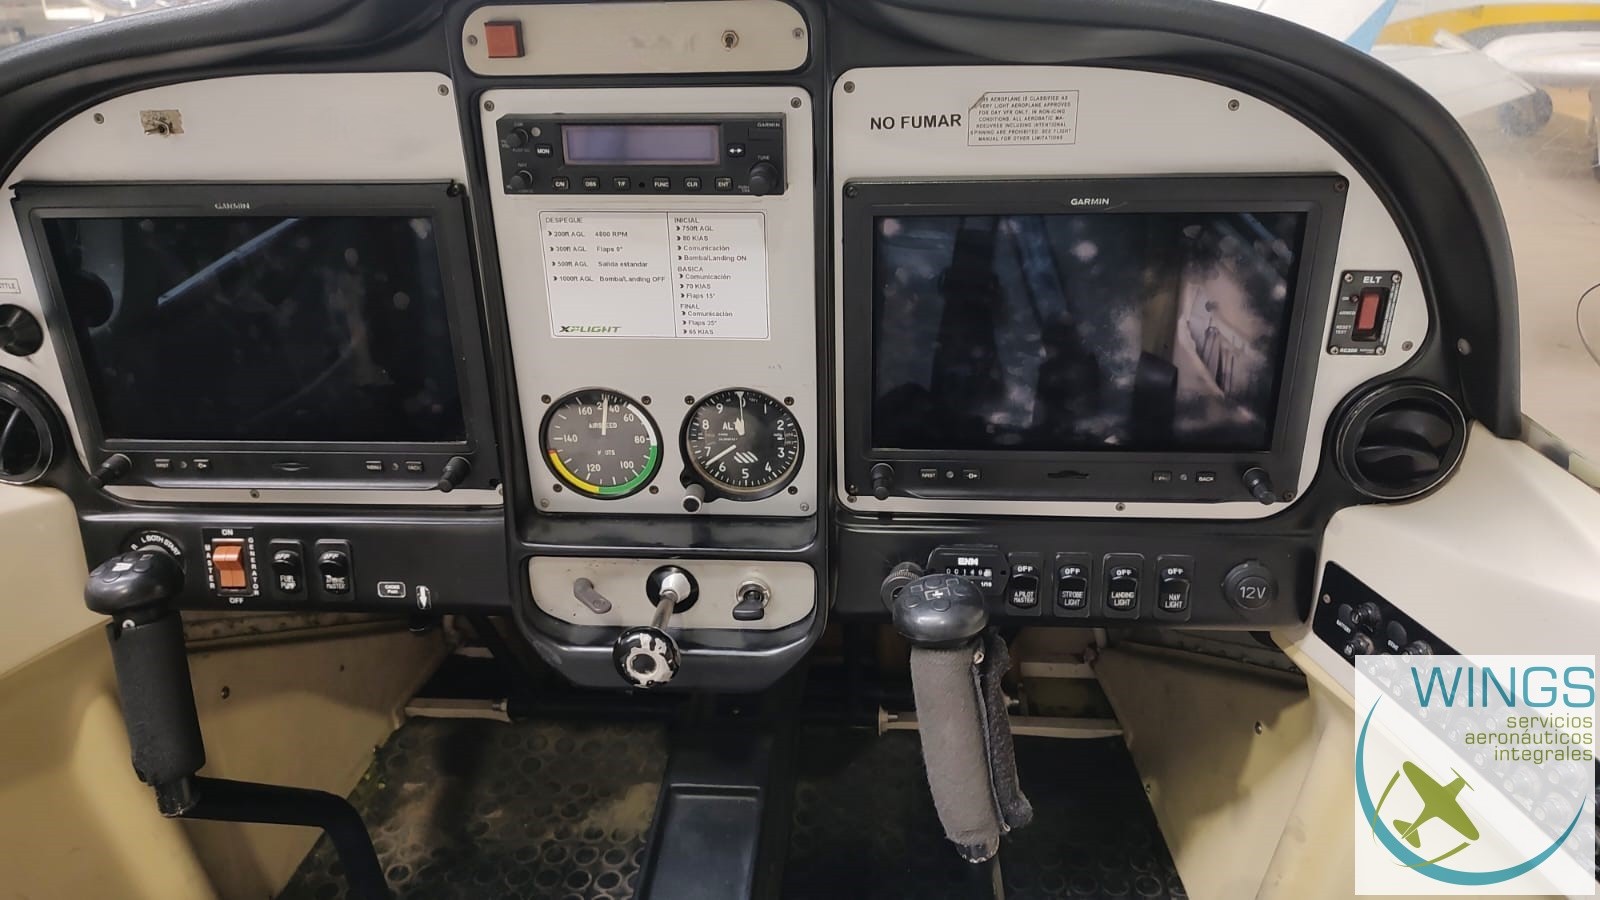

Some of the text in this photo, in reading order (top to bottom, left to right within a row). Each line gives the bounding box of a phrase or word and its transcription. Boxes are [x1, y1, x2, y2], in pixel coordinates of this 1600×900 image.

[871, 114, 961, 130] NO FUMAR
[578, 407, 592, 415] 160
[716, 404, 723, 414] 9
[624, 414, 634, 422] 60
[702, 420, 709, 429] 8
[777, 420, 784, 430] 2
[704, 447, 711, 456] 7
[778, 447, 785, 458] 3
[719, 462, 726, 472] 6
[765, 462, 771, 472] 4
[742, 468, 749, 478] 5
[163, 539, 181, 556] START
[204, 544, 216, 589] MASTER
[248, 537, 260, 596] GENERATOR
[1240, 586, 1266, 599] 12V
